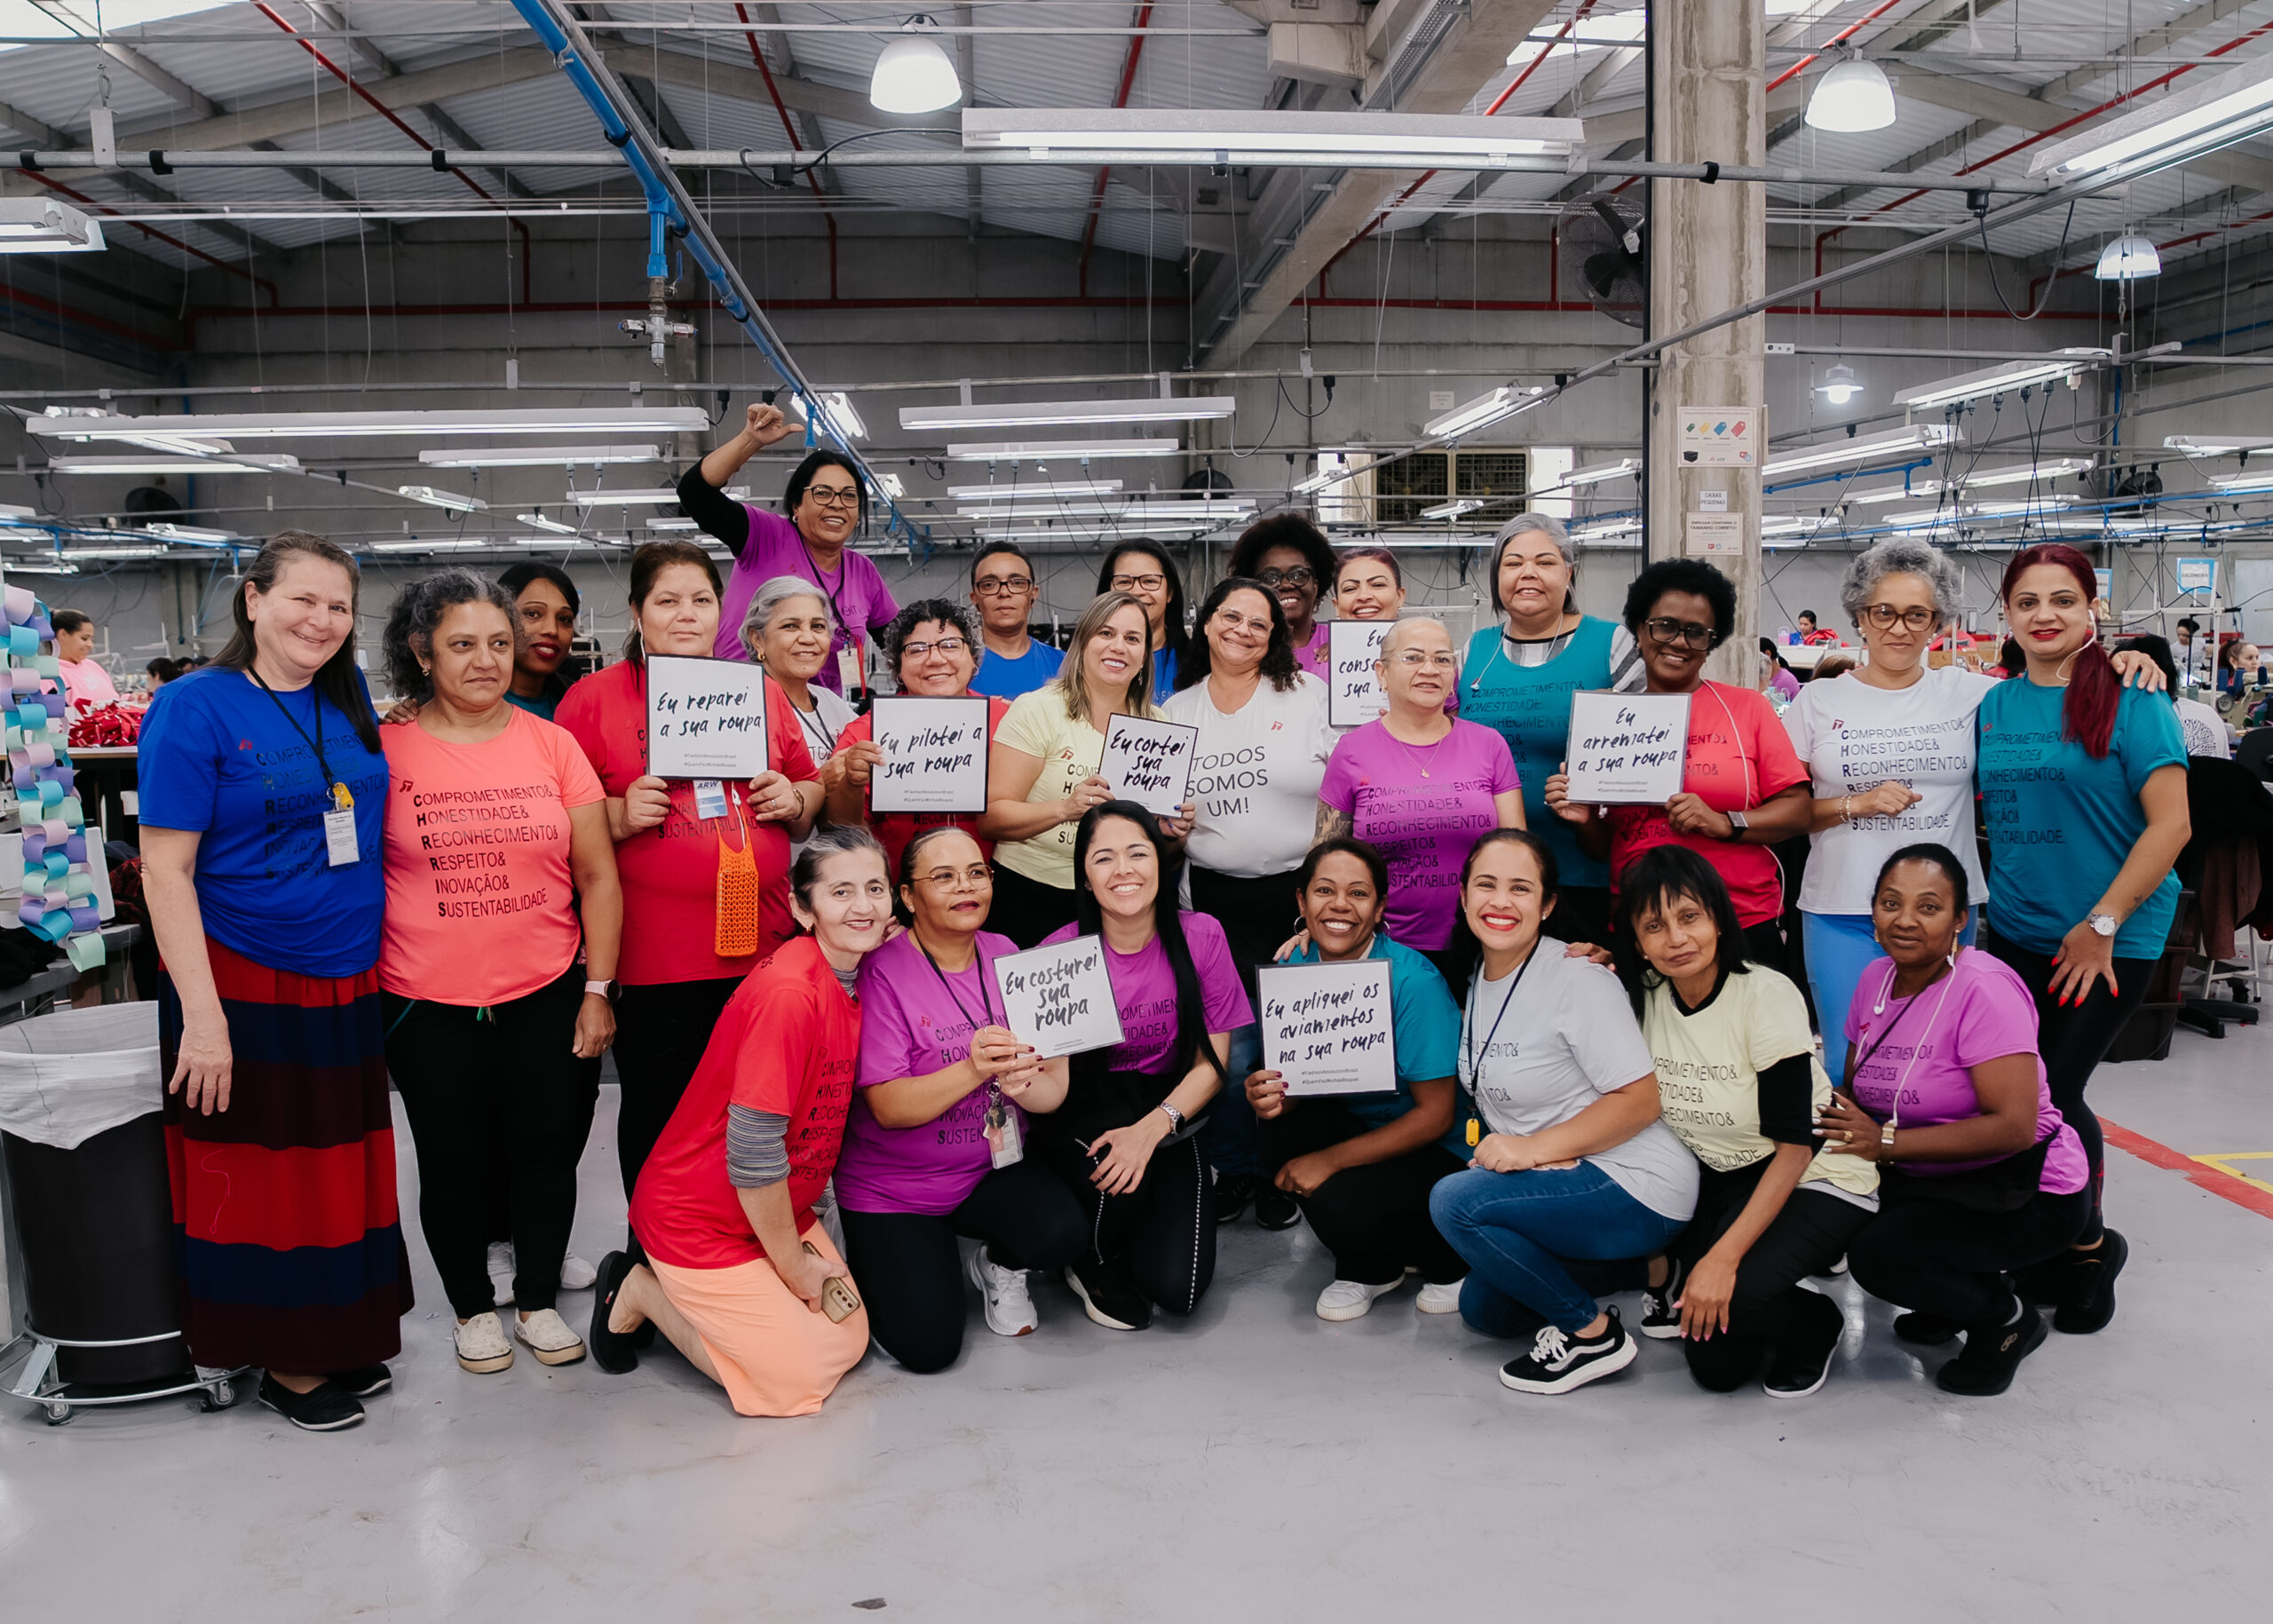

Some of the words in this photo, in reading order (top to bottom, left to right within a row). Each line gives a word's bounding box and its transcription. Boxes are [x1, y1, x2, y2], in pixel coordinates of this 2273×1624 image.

[657, 692, 678, 715] Eu
[686, 685, 749, 711] reparei
[1343, 682, 1371, 698] sua
[660, 724, 670, 737] a
[678, 719, 709, 738] sua
[718, 715, 762, 733] roupa
[1615, 707, 1636, 727] Eu
[907, 722, 966, 754] pilotei
[972, 726, 983, 741] a
[1583, 723, 1673, 750] arrematei
[1841, 718, 1965, 740] COMPROMETIMENTO&
[1110, 728, 1133, 756] Eu
[1134, 734, 1190, 756] cortei
[1841, 738, 1940, 757] HONESTIDADE&
[884, 761, 915, 780] sua
[924, 753, 973, 773] roupa
[1131, 755, 1163, 775] sua
[1192, 746, 1265, 772] TODOS
[1578, 760, 1588, 772] a
[1595, 757, 1625, 772] sua
[1632, 749, 1678, 767] roupa
[1842, 756, 1968, 778] RECONHECIMENTO&
[697, 780, 719, 789] ARW
[1123, 771, 1172, 792] roupa
[1185, 769, 1269, 797] SOMOS
[413, 784, 553, 807] COMPROMETIMENTO&
[1207, 796, 1249, 817] UM!
[1366, 796, 1464, 817] HONESTIDADE&
[416, 805, 530, 827] HONESTIDADE&
[1366, 814, 1492, 836] RECONHECIMENTO&
[421, 825, 558, 850] RECONHECIMENTO&
[429, 851, 506, 871] RESPEITO&
[435, 874, 511, 897] INOVAÇÃO&
[438, 888, 549, 918] SUSTENTABILIDADE
[1005, 970, 1026, 996] Eu
[1029, 946, 1097, 987] costurei
[1037, 982, 1071, 1010] sua
[1265, 998, 1285, 1020] Eu
[1292, 983, 1356, 1016] apliquei
[1363, 982, 1380, 999] os
[1034, 998, 1089, 1032] roupa
[1279, 1007, 1374, 1040] aviamentos
[1122, 1021, 1168, 1042] TIDADE&
[1279, 1050, 1296, 1065] na
[1304, 1042, 1333, 1060] sua
[1342, 1031, 1386, 1053] roupa
[1658, 1081, 1704, 1104] STIDADE&
[1662, 1106, 1736, 1127] HECIMENTO&
